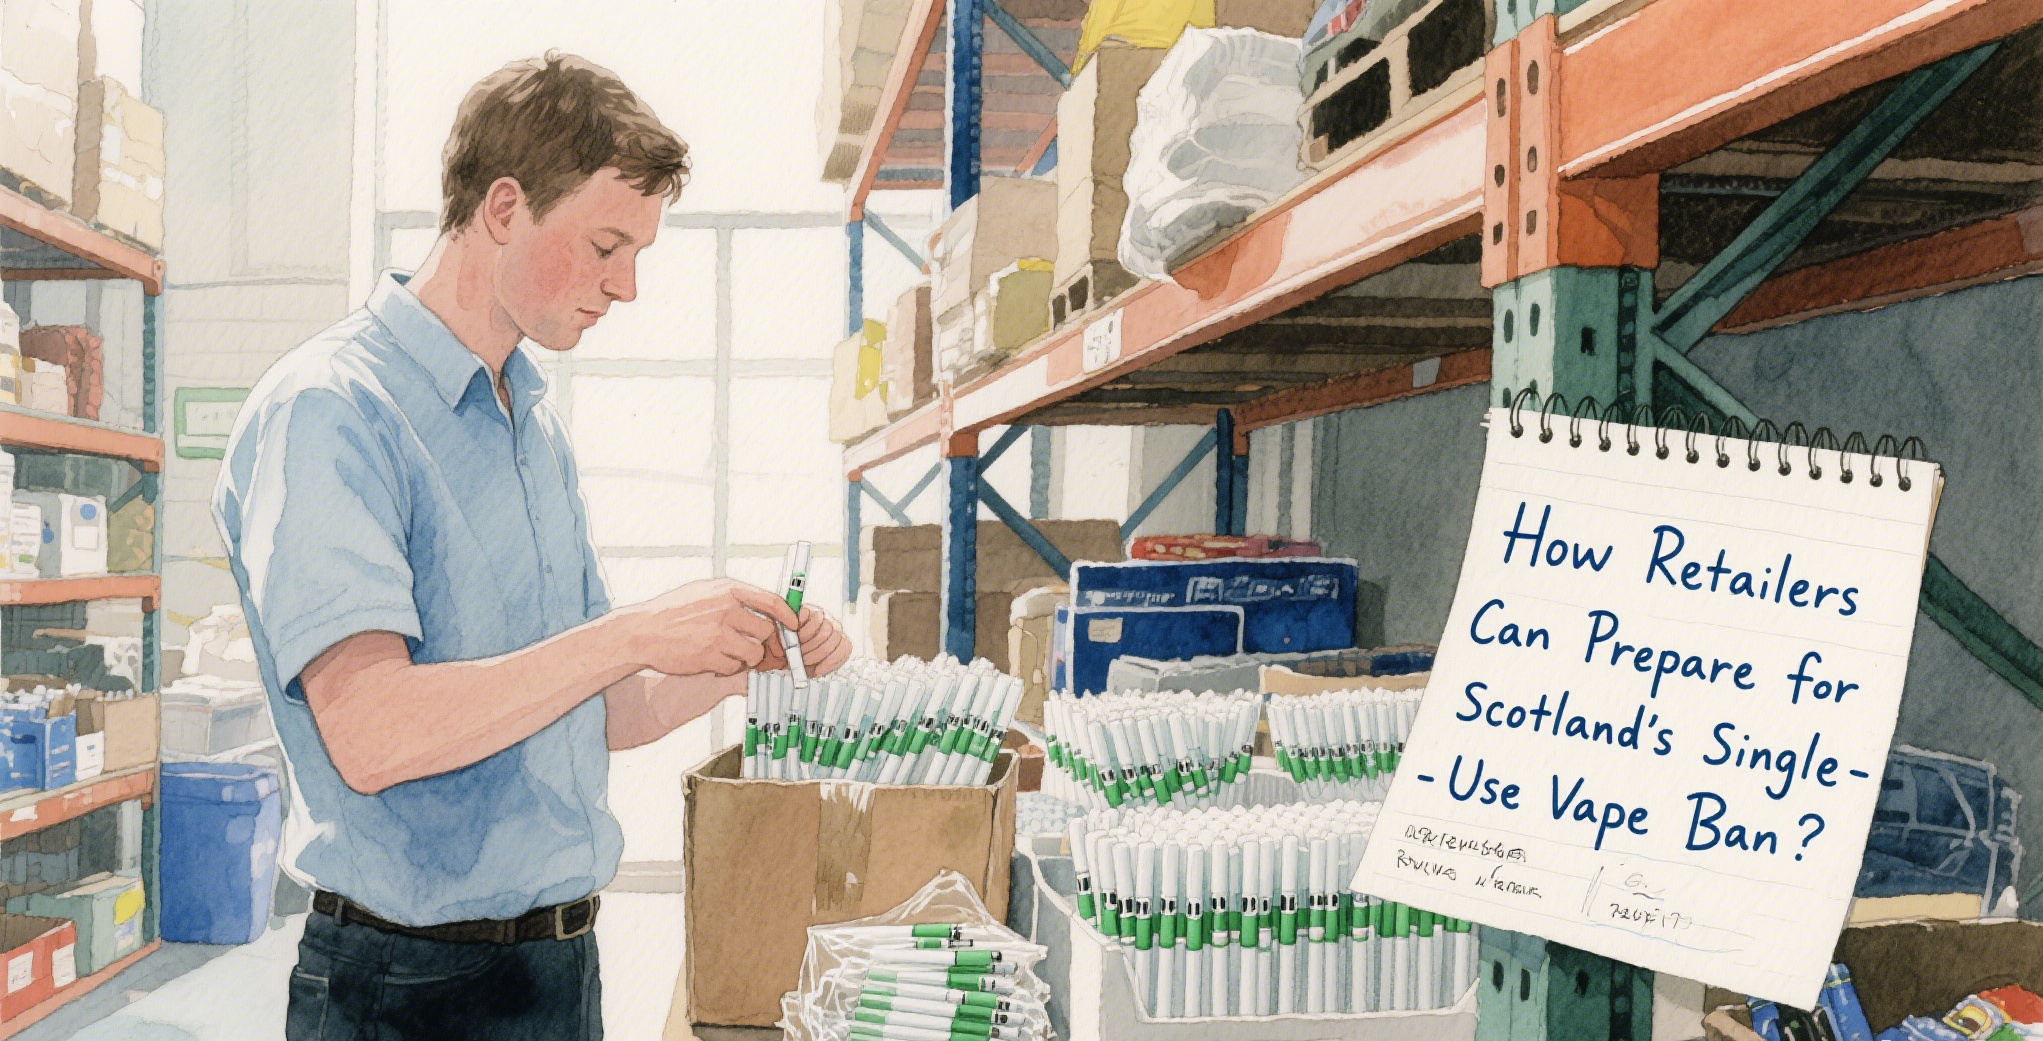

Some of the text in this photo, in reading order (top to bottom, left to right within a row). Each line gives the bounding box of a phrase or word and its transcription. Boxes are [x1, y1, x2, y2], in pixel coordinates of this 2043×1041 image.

[1502, 501, 1859, 617] How Retailers
[1469, 597, 1860, 706] Can Prepare for
[1455, 681, 1870, 802] Scotland's Single-
[1550, 774, 1649, 851] Vape
